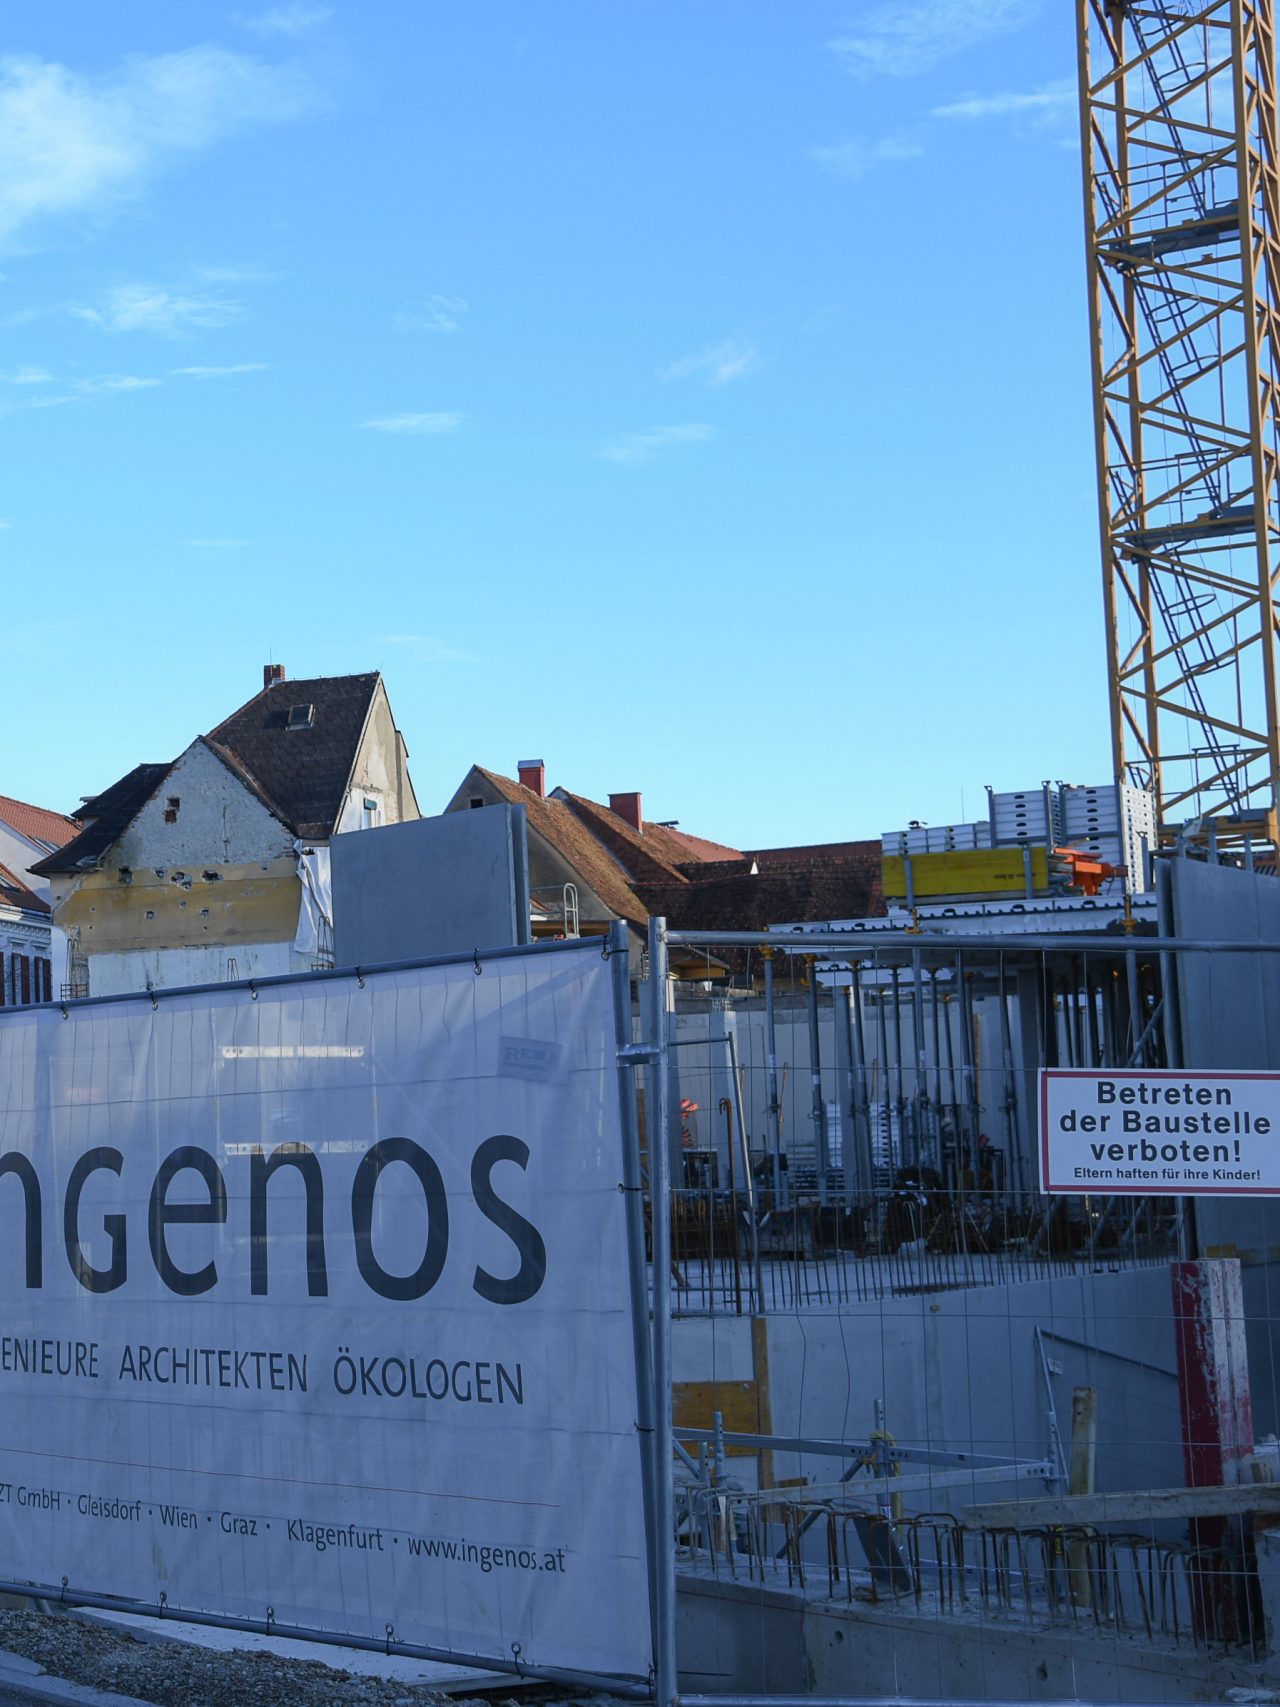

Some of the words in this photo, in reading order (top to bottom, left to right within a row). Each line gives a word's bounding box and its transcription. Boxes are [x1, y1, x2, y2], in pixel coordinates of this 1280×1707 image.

[1097, 1081, 1232, 1106] Betreten
[1059, 1109, 1111, 1132] der
[1122, 1109, 1271, 1135] Baustelle
[1090, 1138, 1241, 1163] verboten!
[1074, 1167, 1113, 1179] Eltern
[1116, 1168, 1158, 1180] haften
[1161, 1168, 1180, 1180] für
[1183, 1168, 1209, 1180] ihre
[1212, 1169, 1261, 1181] Kinder!
[118, 1344, 308, 1393] ARCHITEKTEN
[332, 1346, 524, 1405] ÖKOLOGEN
[17, 1486, 61, 1511] GmbH
[77, 1494, 142, 1522] Gleisdorf
[159, 1504, 198, 1530] Wien
[220, 1511, 258, 1537] Graz
[286, 1518, 384, 1552] Klagenfurt
[407, 1537, 567, 1573] www.ingenos.at
